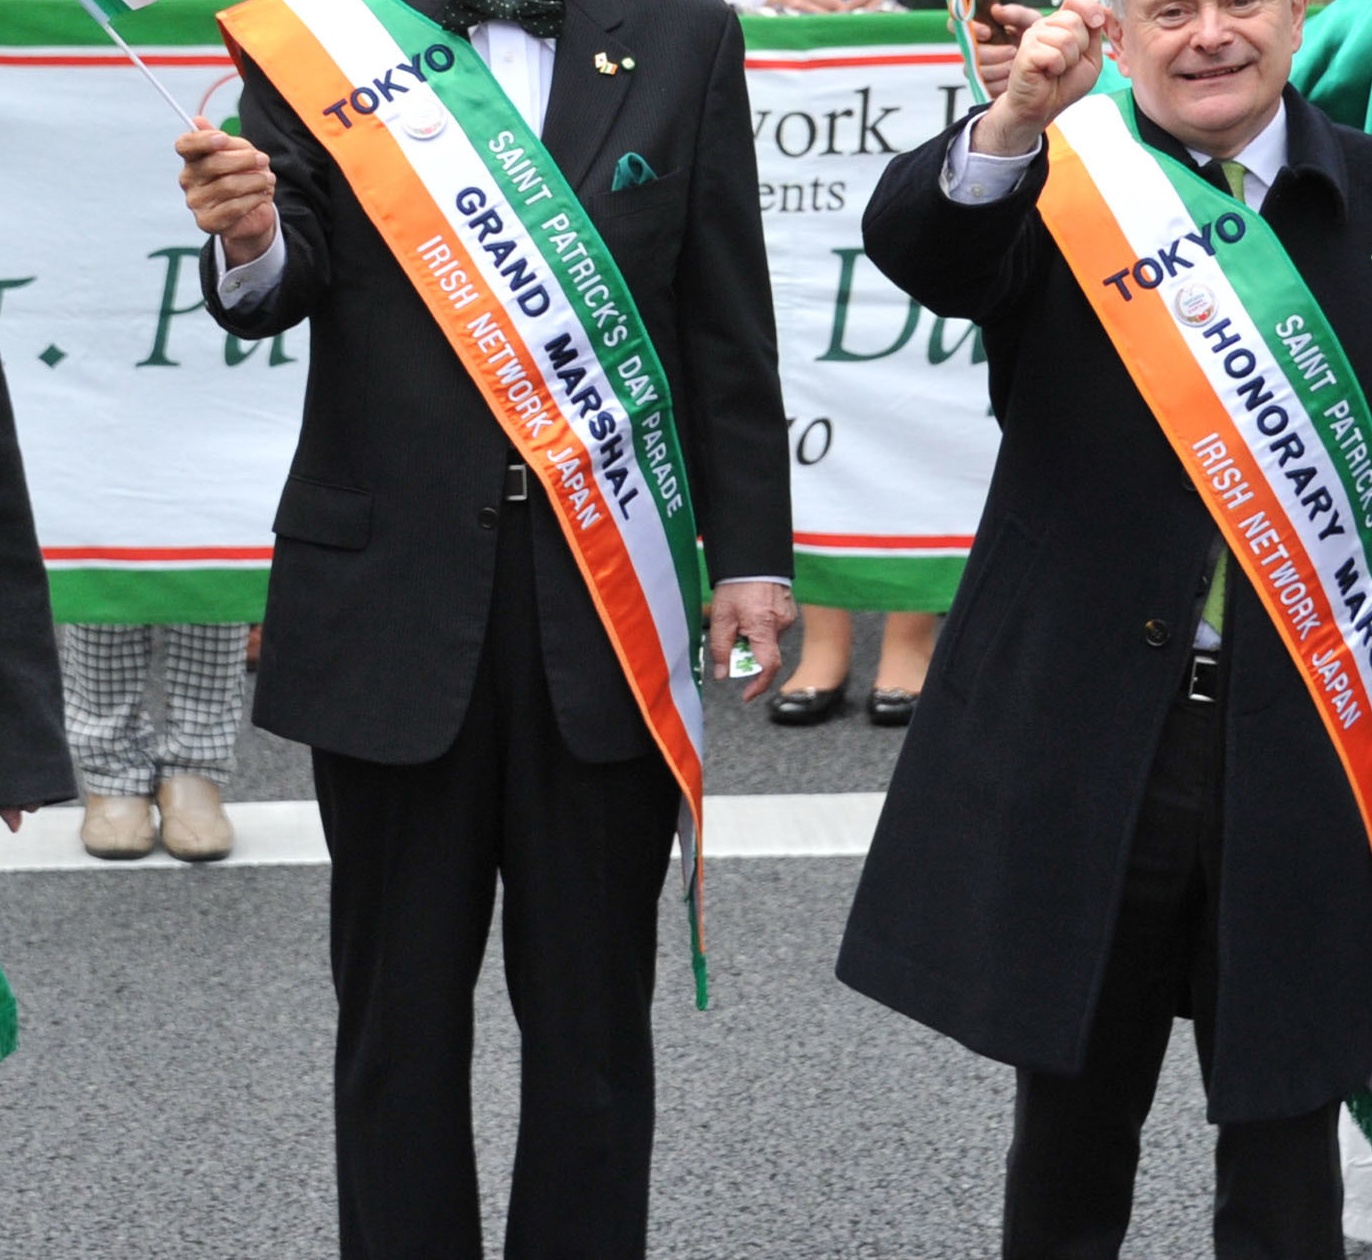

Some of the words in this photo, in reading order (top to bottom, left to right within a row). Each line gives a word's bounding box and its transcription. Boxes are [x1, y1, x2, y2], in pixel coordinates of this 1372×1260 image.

[321, 42, 456, 129] TOKYO
[415, 234, 480, 311] IRISH
[466, 311, 555, 439] NETWORK
[546, 445, 602, 532] JAPAN
[454, 185, 552, 319] GRAND
[542, 331, 640, 521] MARSHAL
[487, 129, 553, 208] SAINT
[540, 212, 629, 349] PATRICK'S
[616, 354, 659, 408] DAY
[640, 410, 684, 519] PARADE
[1102, 210, 1247, 303] TOKYO
[1274, 313, 1337, 393] SAINT
[1201, 317, 1346, 542] HONORARY
[1191, 431, 1255, 512] IRISH
[1237, 510, 1323, 642] NETWORK
[1311, 648, 1362, 731] JAPAN
